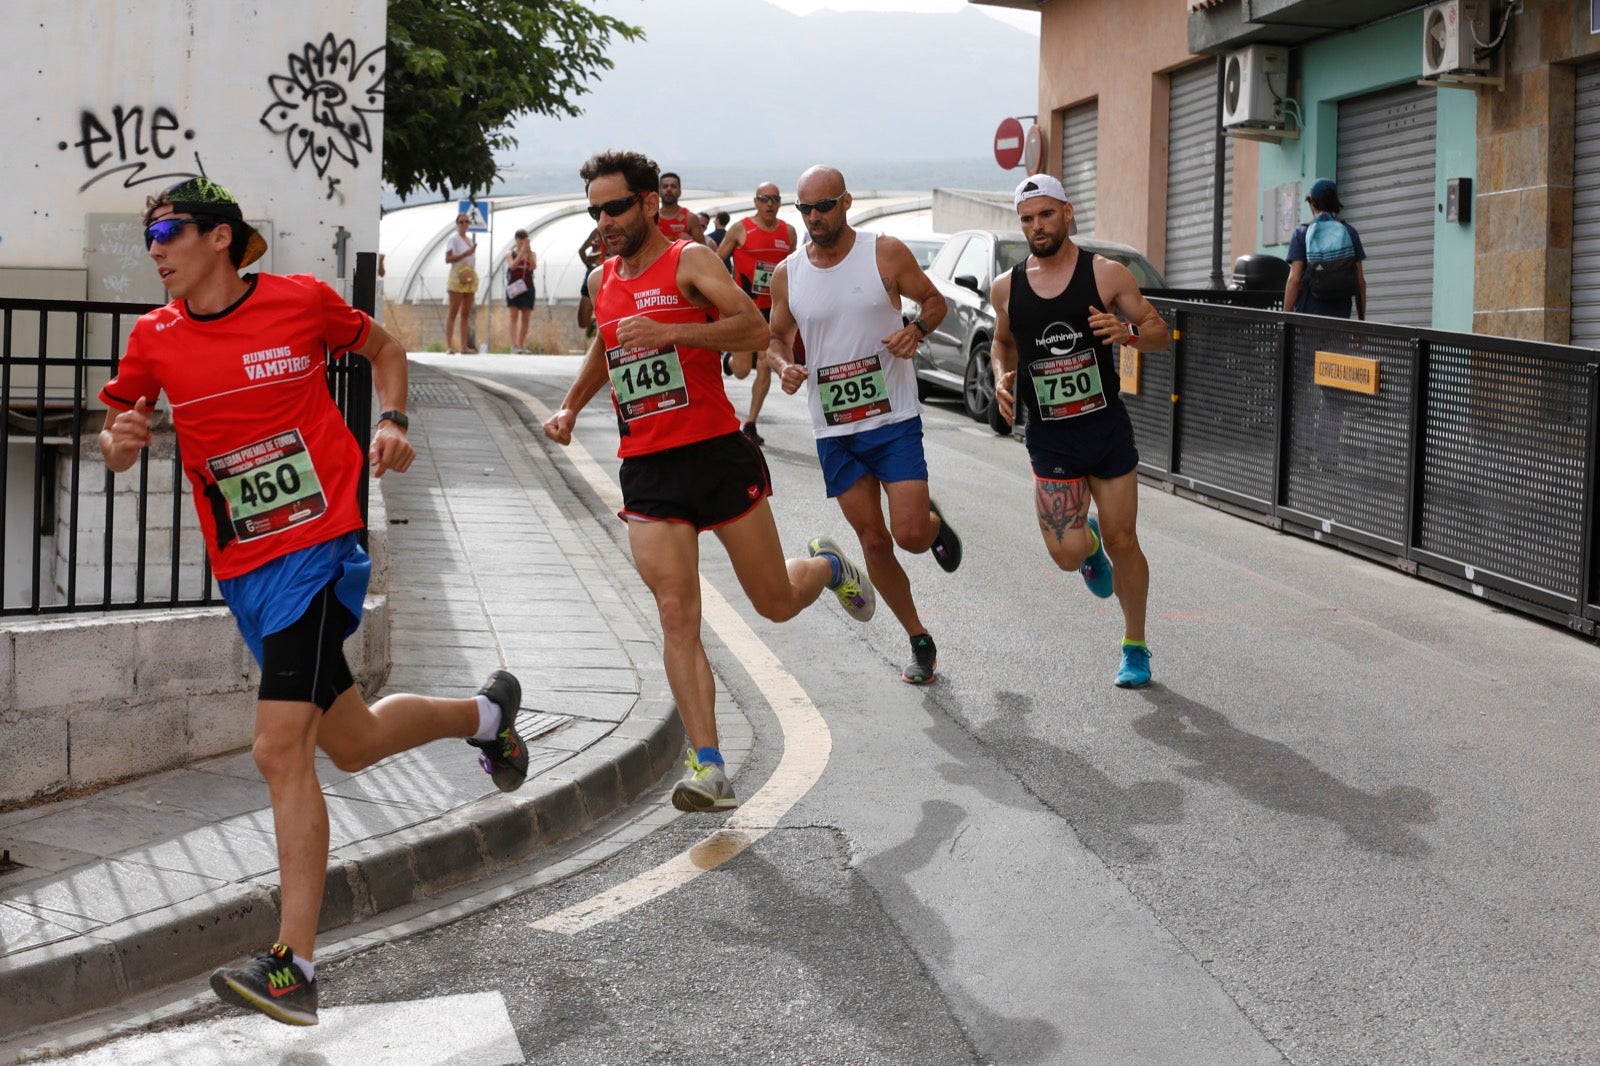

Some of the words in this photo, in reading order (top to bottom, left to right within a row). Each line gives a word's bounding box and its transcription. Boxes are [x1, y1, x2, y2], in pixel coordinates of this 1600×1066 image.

[634, 288, 660, 300] RUNNING
[635, 295, 678, 310] VAMPIROS
[1036, 332, 1083, 346] healthiness
[242, 346, 291, 365] RUNNING
[840, 361, 857, 373] PREMIO
[856, 360, 863, 369] DE
[622, 360, 671, 394] 148
[830, 375, 877, 407] 295
[1044, 372, 1091, 400] 750
[264, 440, 276, 452] DE
[241, 463, 301, 507] 460
